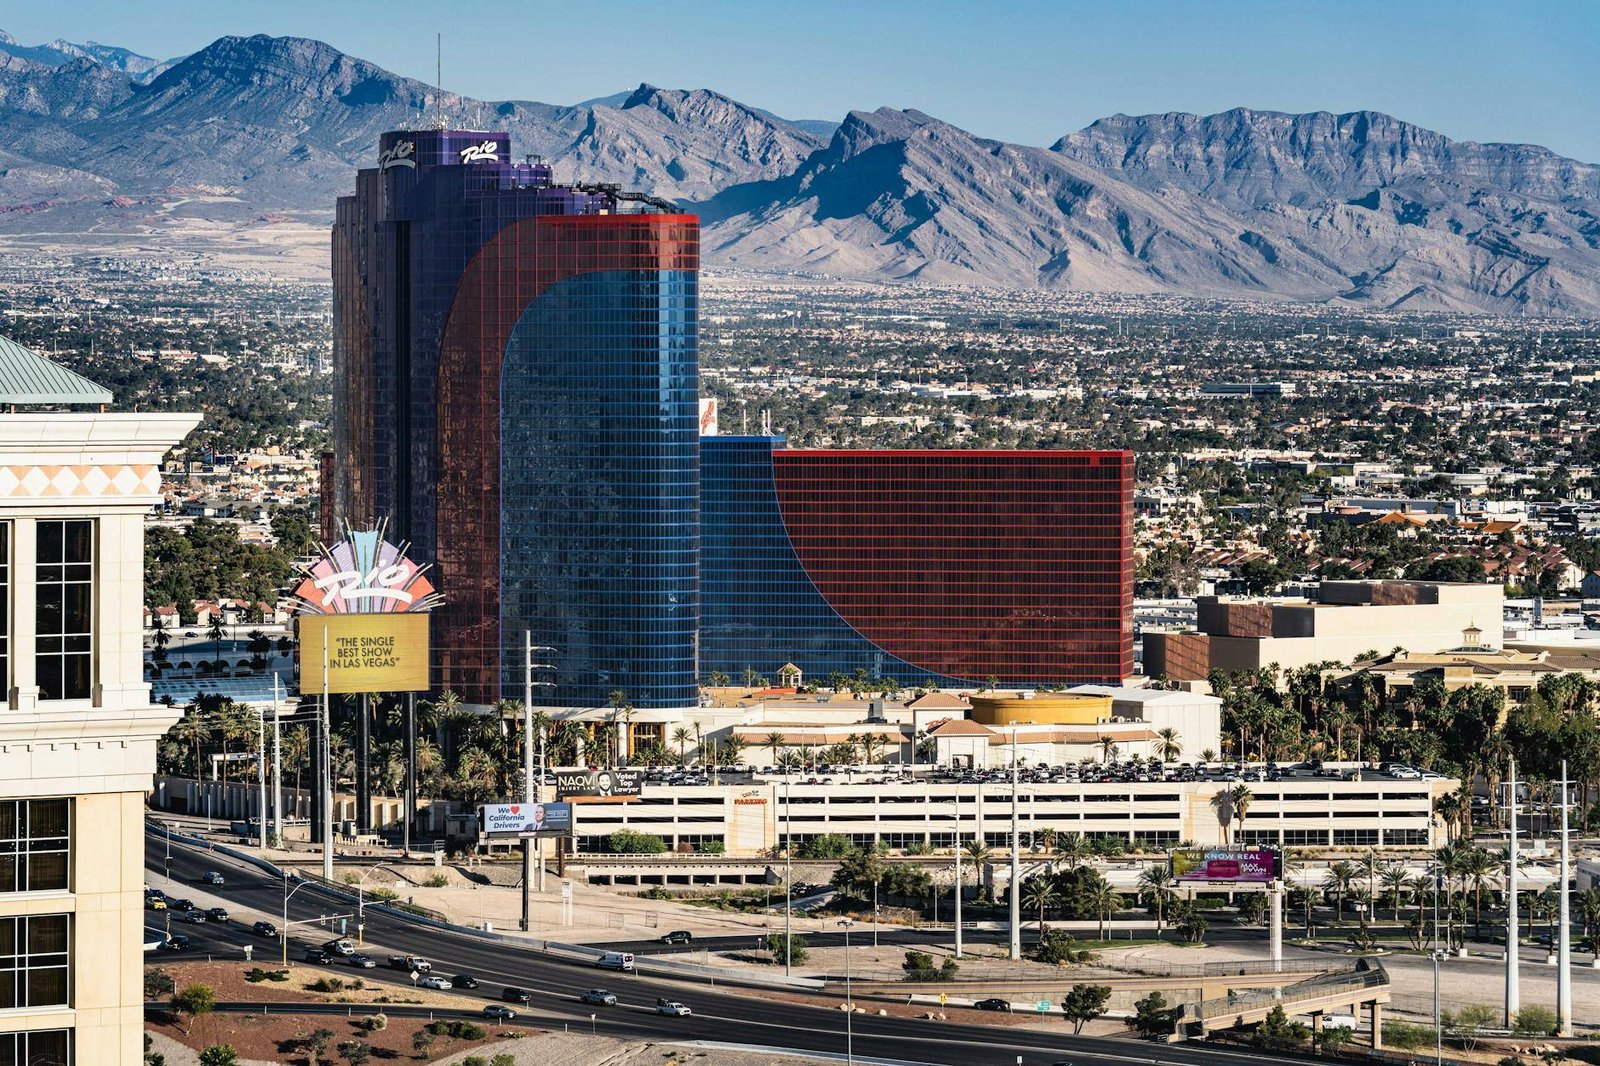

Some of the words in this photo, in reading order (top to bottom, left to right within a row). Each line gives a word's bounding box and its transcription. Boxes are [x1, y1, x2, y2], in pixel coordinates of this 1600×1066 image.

[377, 140, 416, 175] Rio
[460, 140, 499, 164] Rio
[314, 559, 413, 606] Rio
[360, 636, 395, 647] SINGLE
[337, 647, 359, 658] BEST
[361, 647, 393, 657] SHOW
[329, 659, 341, 668] IN
[343, 658, 360, 668] LAS
[558, 775, 596, 787] NAQVI
[615, 772, 637, 780] Voted
[619, 779, 633, 788] Top
[488, 814, 525, 822] California
[1204, 852, 1235, 860] KNOW
